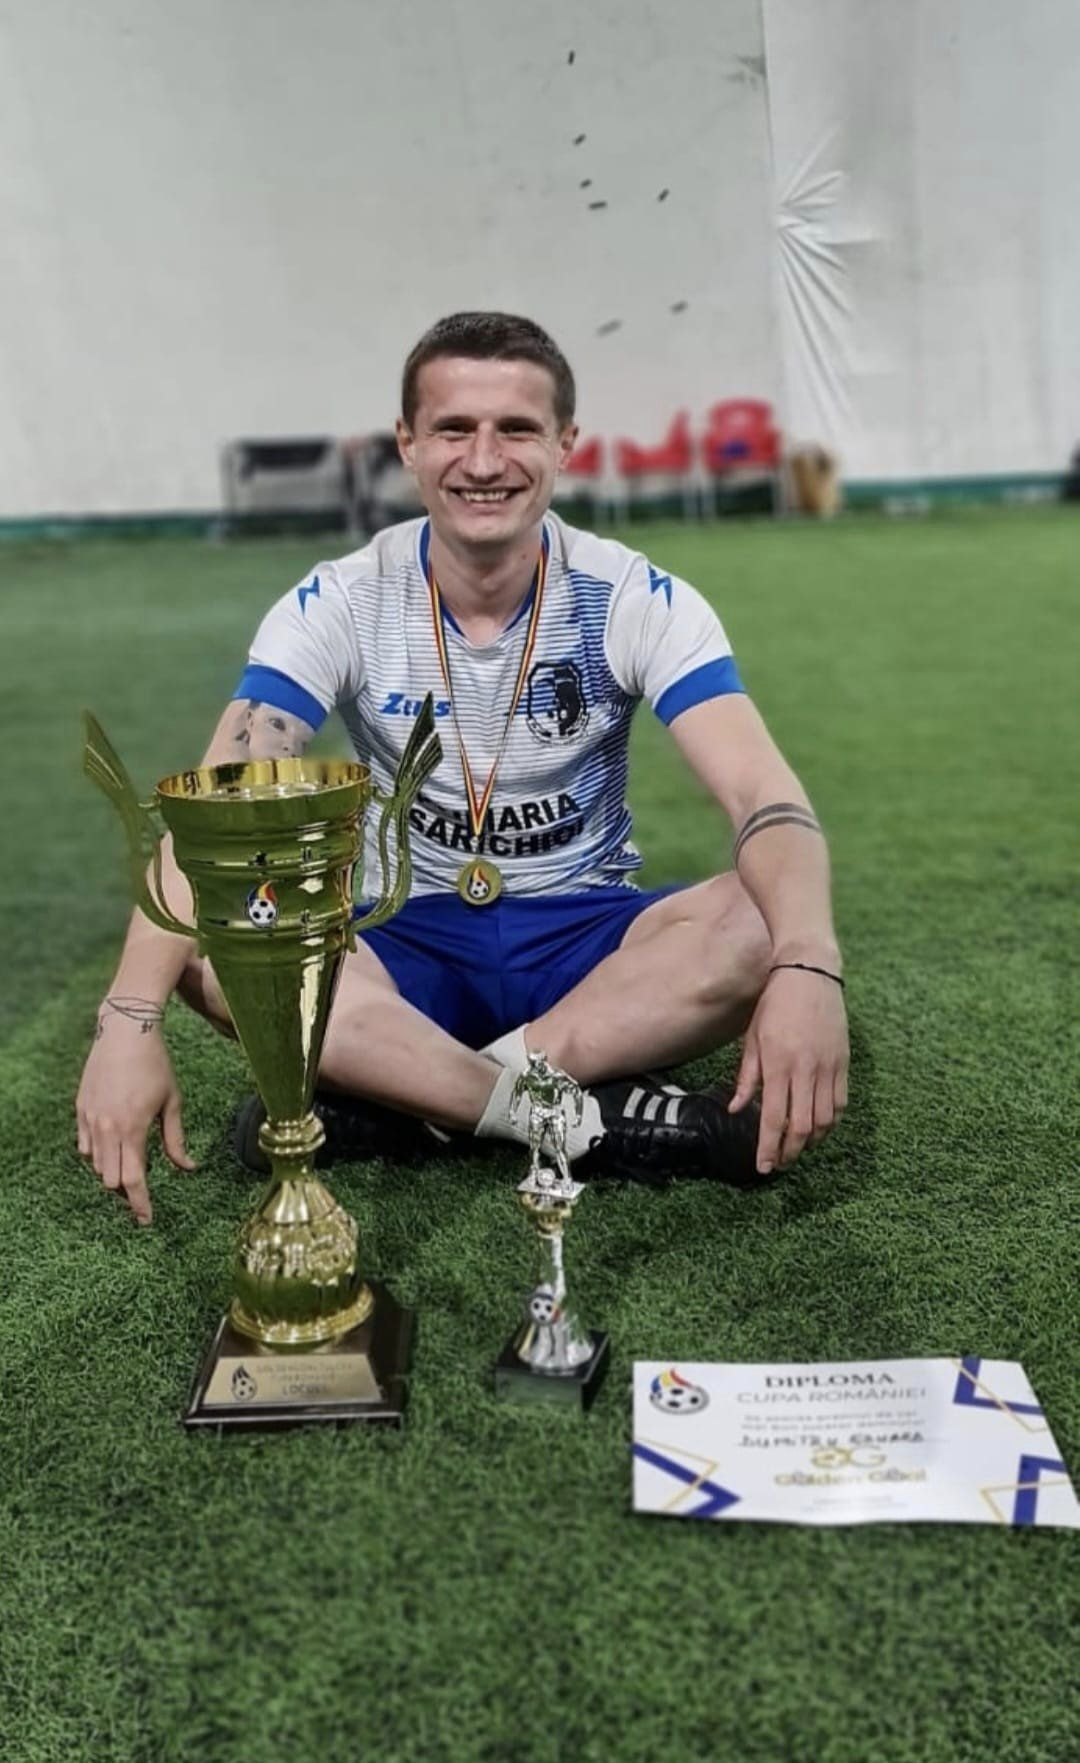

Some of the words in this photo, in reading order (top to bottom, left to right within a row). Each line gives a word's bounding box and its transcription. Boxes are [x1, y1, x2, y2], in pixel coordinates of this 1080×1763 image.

[416, 793, 581, 834] MARIA
[764, 1373, 896, 1388] DIPLOMA
[737, 1390, 803, 1404] CUPA
